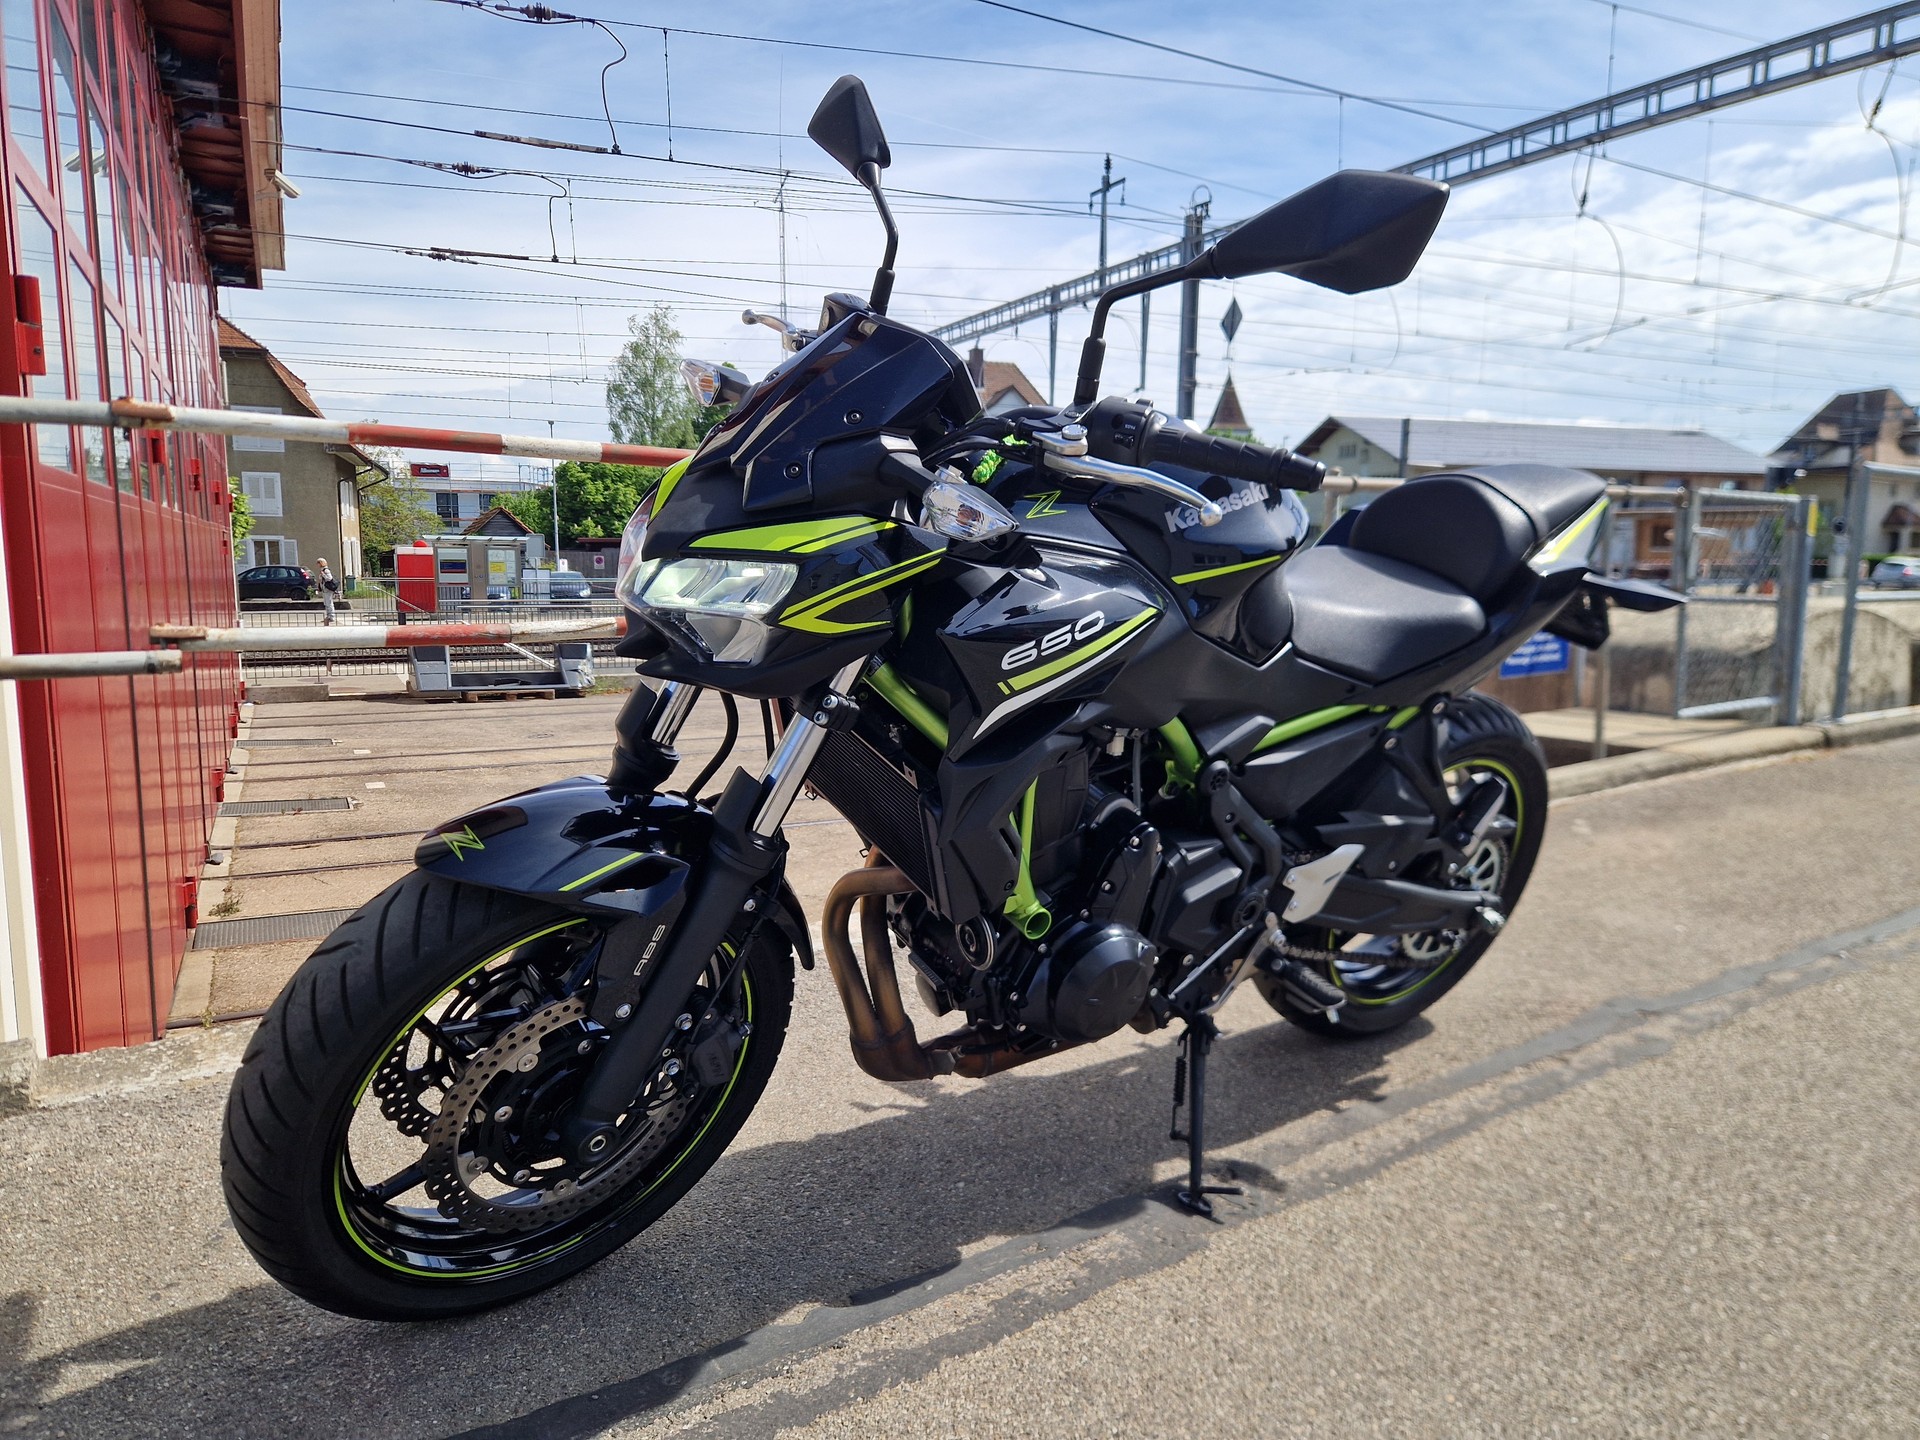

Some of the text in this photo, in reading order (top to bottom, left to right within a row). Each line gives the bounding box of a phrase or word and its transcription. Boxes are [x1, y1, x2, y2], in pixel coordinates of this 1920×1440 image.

[1164, 481, 1269, 533] Kaasaki
[1001, 610, 1105, 671] 650
[633, 924, 666, 976] ABS
